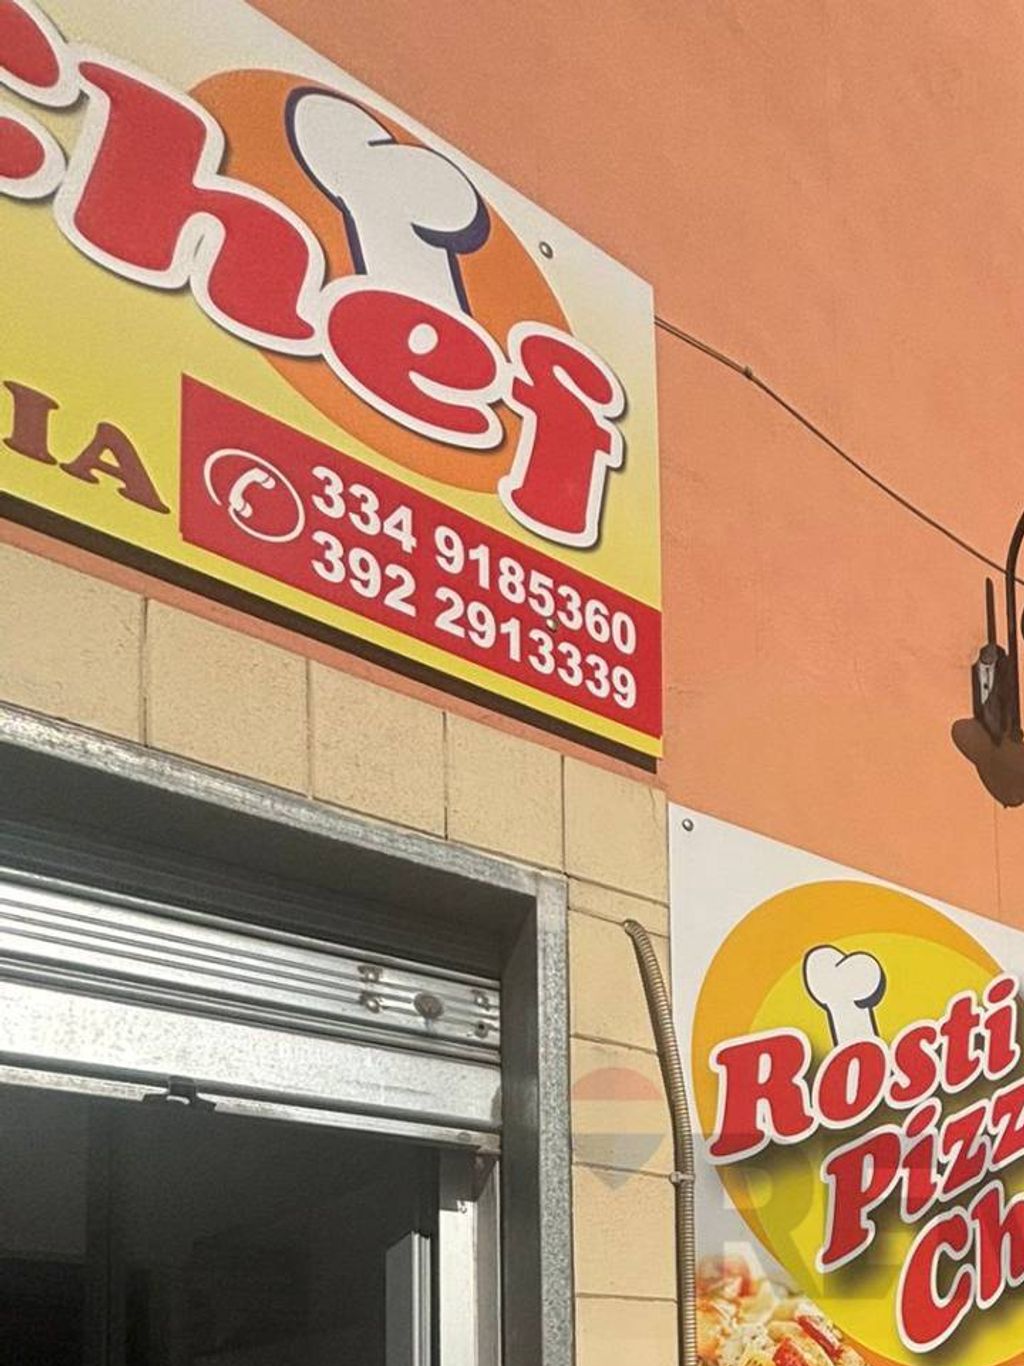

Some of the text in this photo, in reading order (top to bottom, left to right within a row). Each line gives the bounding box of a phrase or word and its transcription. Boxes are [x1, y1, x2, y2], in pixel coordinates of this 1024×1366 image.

[312, 466, 636, 654] 334 9185360
[312, 531, 637, 709] 392 2913339
[709, 975, 1020, 1163] Rosti
